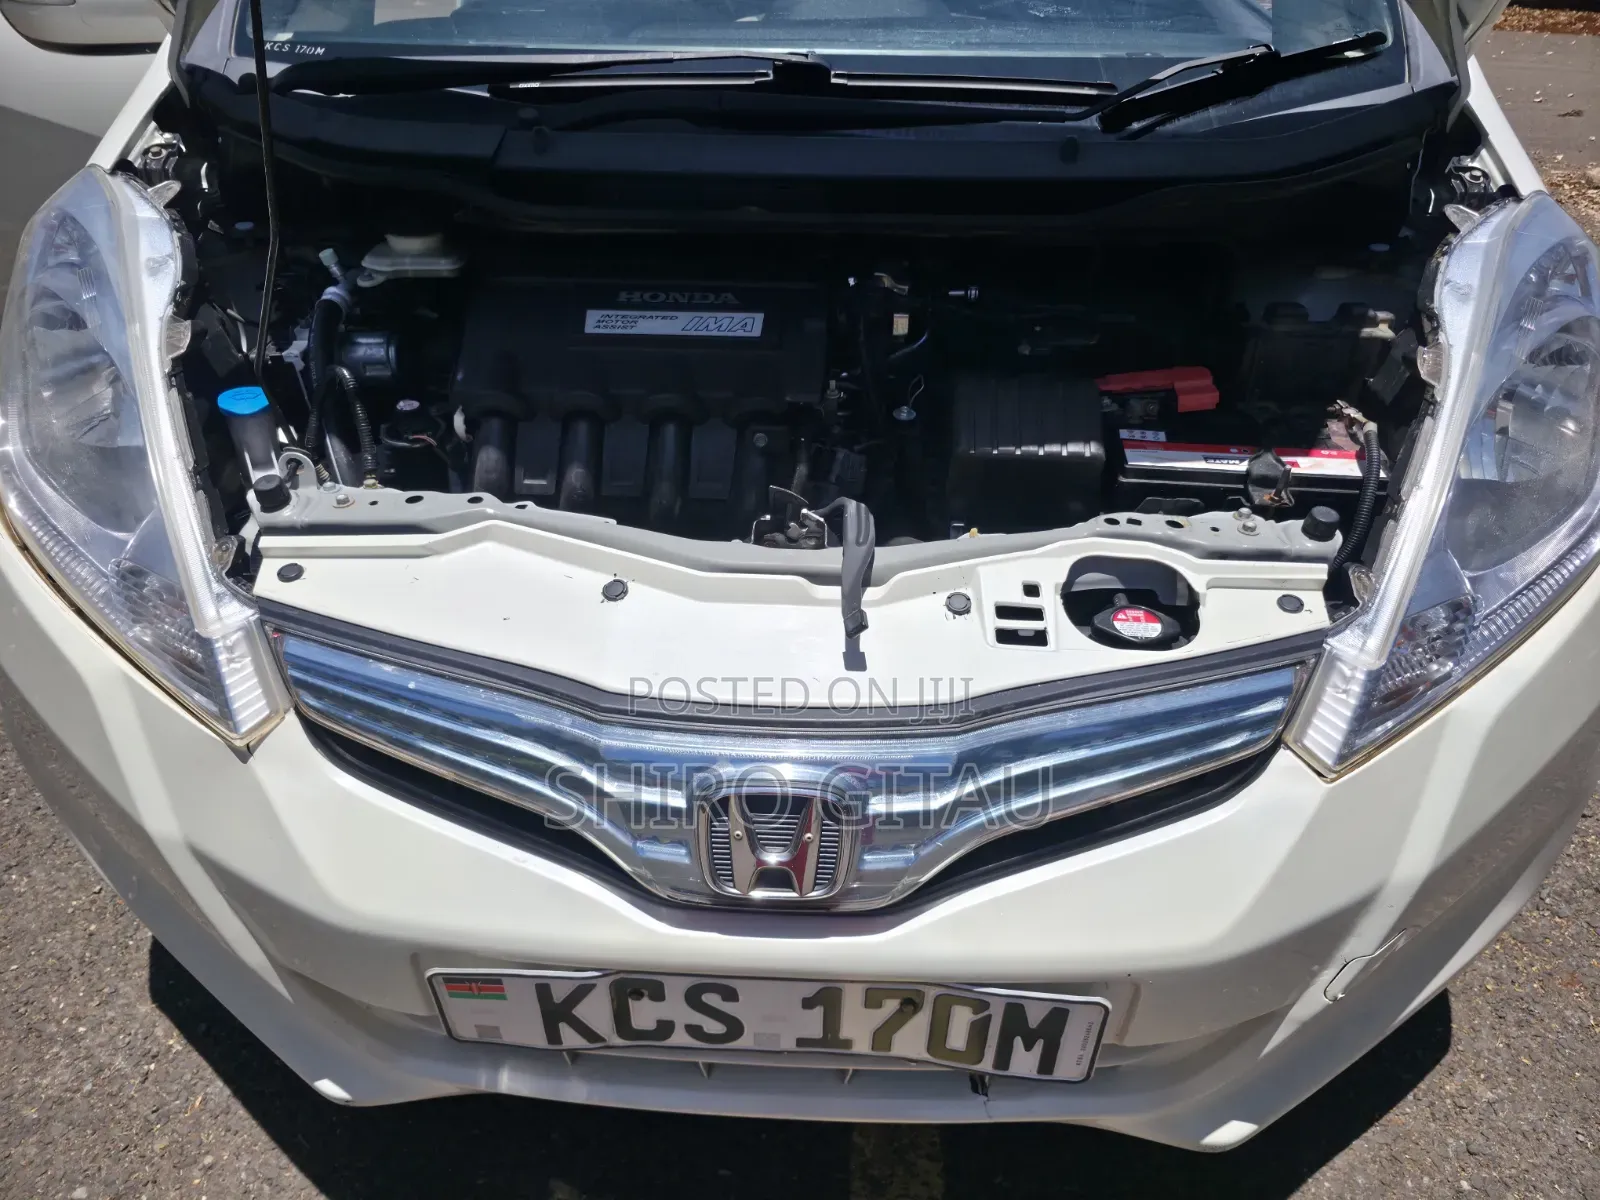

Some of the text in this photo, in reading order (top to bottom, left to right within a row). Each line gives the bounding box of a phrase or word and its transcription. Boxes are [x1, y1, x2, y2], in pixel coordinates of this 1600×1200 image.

[264, 42, 326, 56] KCS 170M
[616, 291, 740, 304] HONDA
[599, 313, 679, 321] INTEGRATED
[681, 315, 756, 333] IMA
[536, 977, 1069, 1076] KCS 170M
